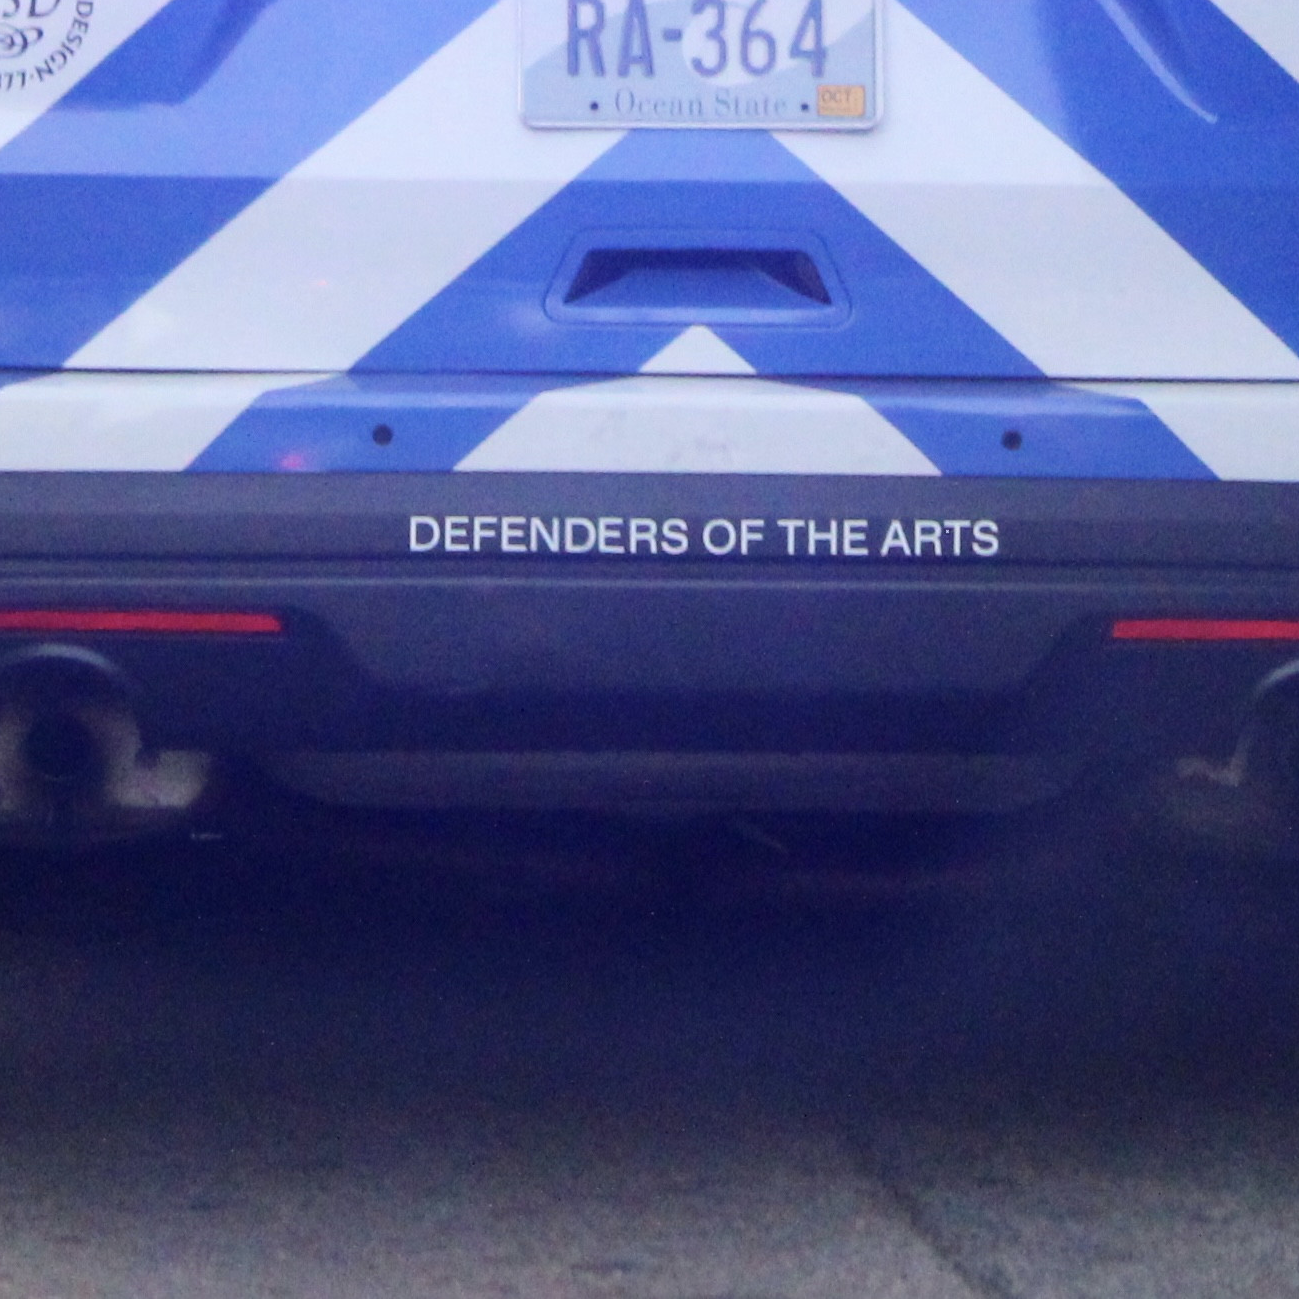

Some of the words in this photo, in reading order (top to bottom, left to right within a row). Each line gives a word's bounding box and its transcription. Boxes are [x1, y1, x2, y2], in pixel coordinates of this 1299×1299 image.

[614, 87, 703, 116] Ocean
[714, 89, 787, 117] State
[821, 90, 852, 103] OCT
[409, 516, 689, 554] DEFENDERS
[702, 518, 764, 555] OF
[777, 519, 869, 556] THE
[881, 520, 1000, 557] ARTS
